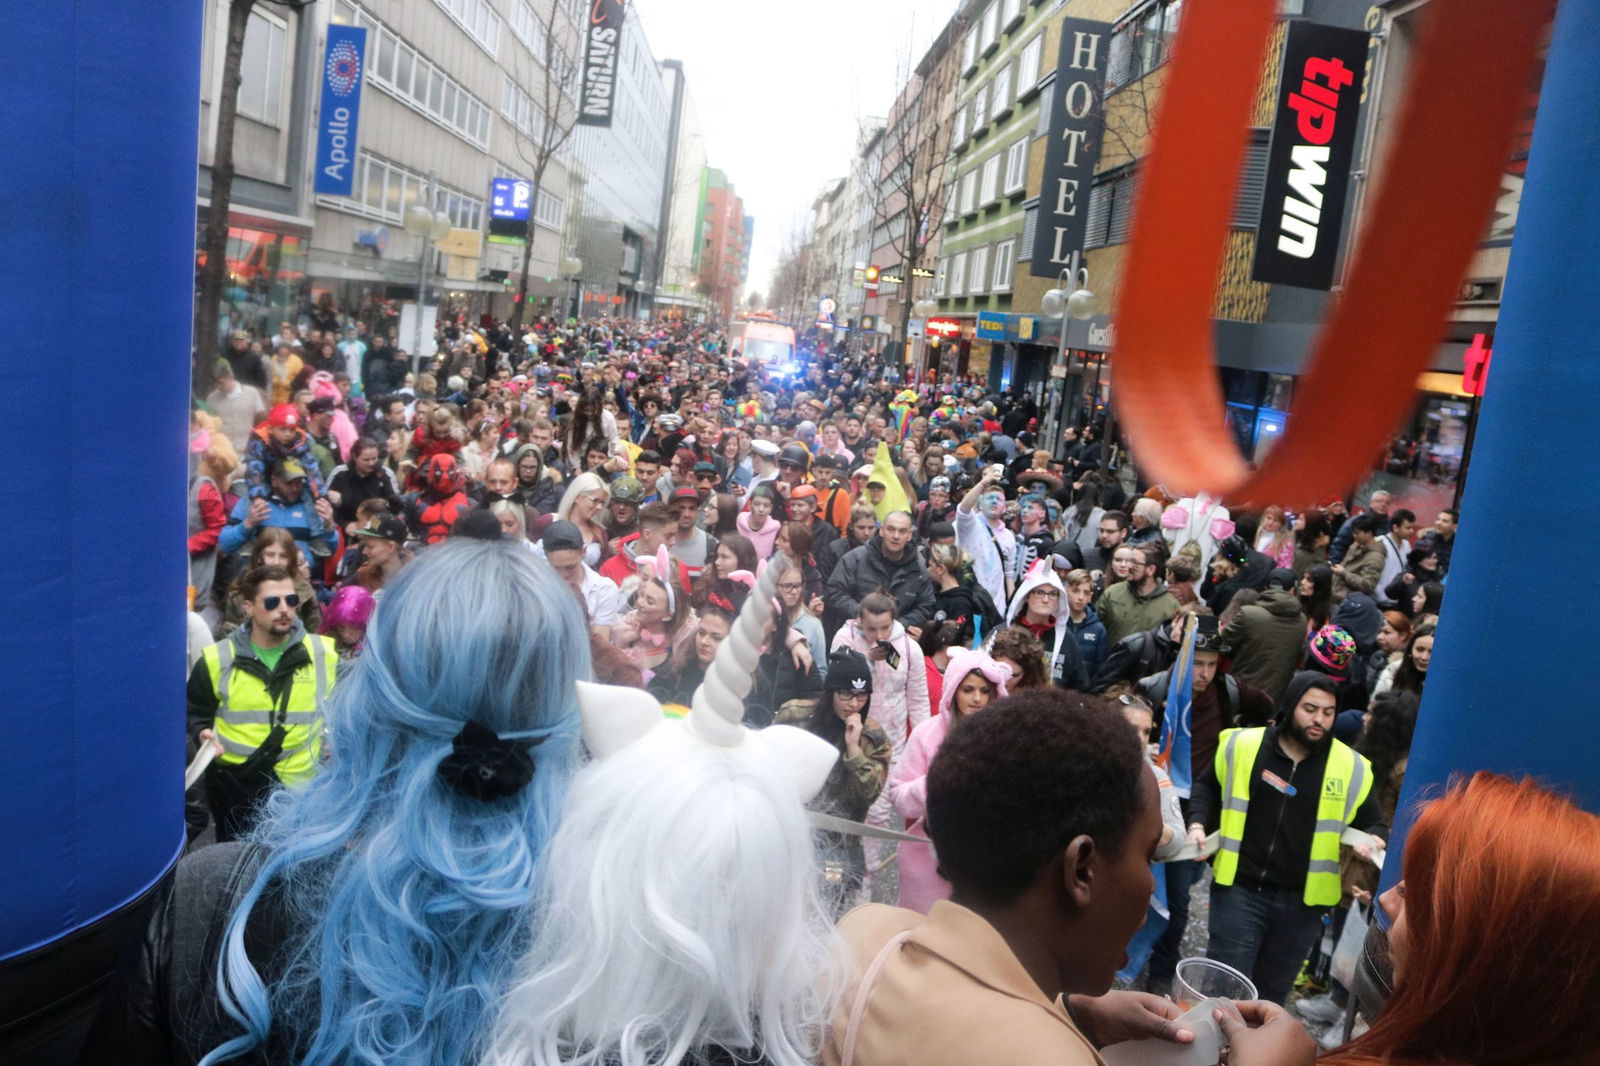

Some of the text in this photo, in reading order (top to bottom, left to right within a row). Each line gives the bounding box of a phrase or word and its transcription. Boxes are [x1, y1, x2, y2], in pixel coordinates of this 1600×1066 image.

[324, 107, 350, 181] Apollo
[583, 26, 617, 117] SATURN
[1050, 31, 1102, 265] HOTEL
[1277, 56, 1354, 259] tipwin
